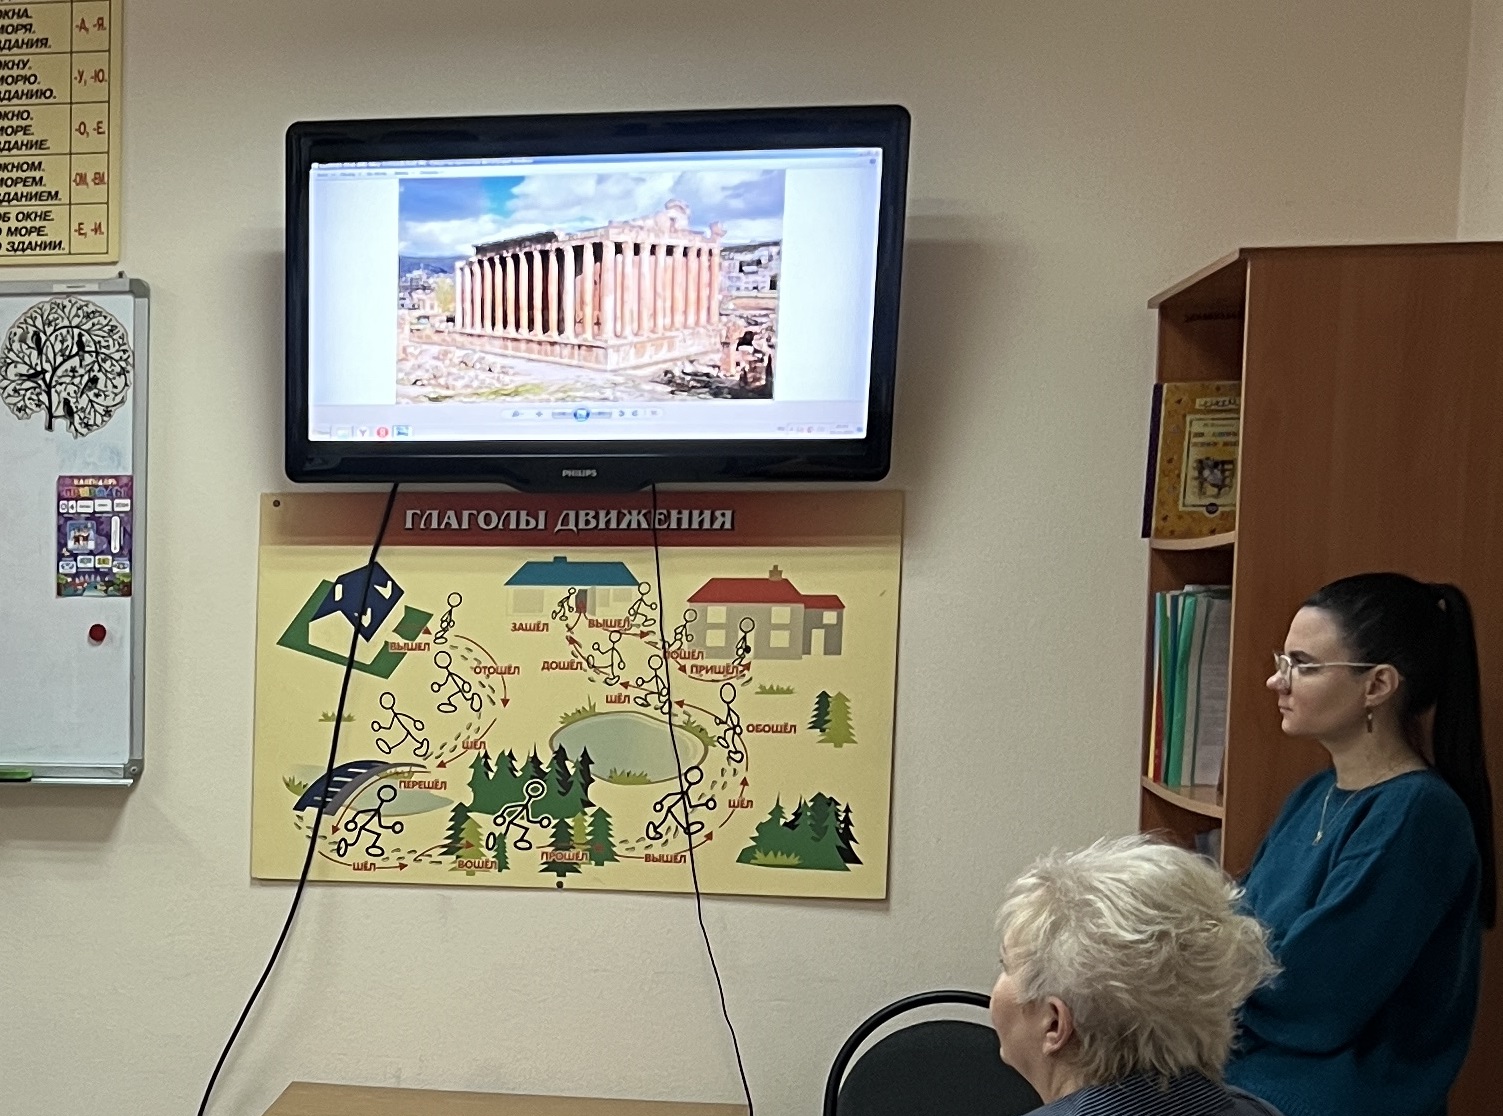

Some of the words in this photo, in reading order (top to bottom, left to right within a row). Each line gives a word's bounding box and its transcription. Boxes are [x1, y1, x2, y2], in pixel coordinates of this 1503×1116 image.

[6, 240, 65, 253] ЗДАНИИ.
[404, 509, 545, 530] ГЛАГОЛЫ
[554, 509, 734, 534] ДВИЖЕНИЯ
[511, 622, 549, 633] ЗАШЁЛ
[474, 665, 520, 675] ОТОШЁЛ
[542, 660, 582, 671] ДОШЁЛ
[691, 664, 739, 675] ПРИШЁЛ
[606, 695, 630, 704] ШЁЛ
[747, 723, 796, 734] ОБОШЁЛ
[462, 740, 486, 749] ШЁЛ
[399, 779, 446, 790] ПЕРЕШЁЛ
[729, 799, 753, 808] ШЁЛ
[541, 851, 588, 861] ПРОШЁЛ
[353, 862, 376, 871] ШЁЛ
[458, 859, 496, 869] ВОШЁЛ
